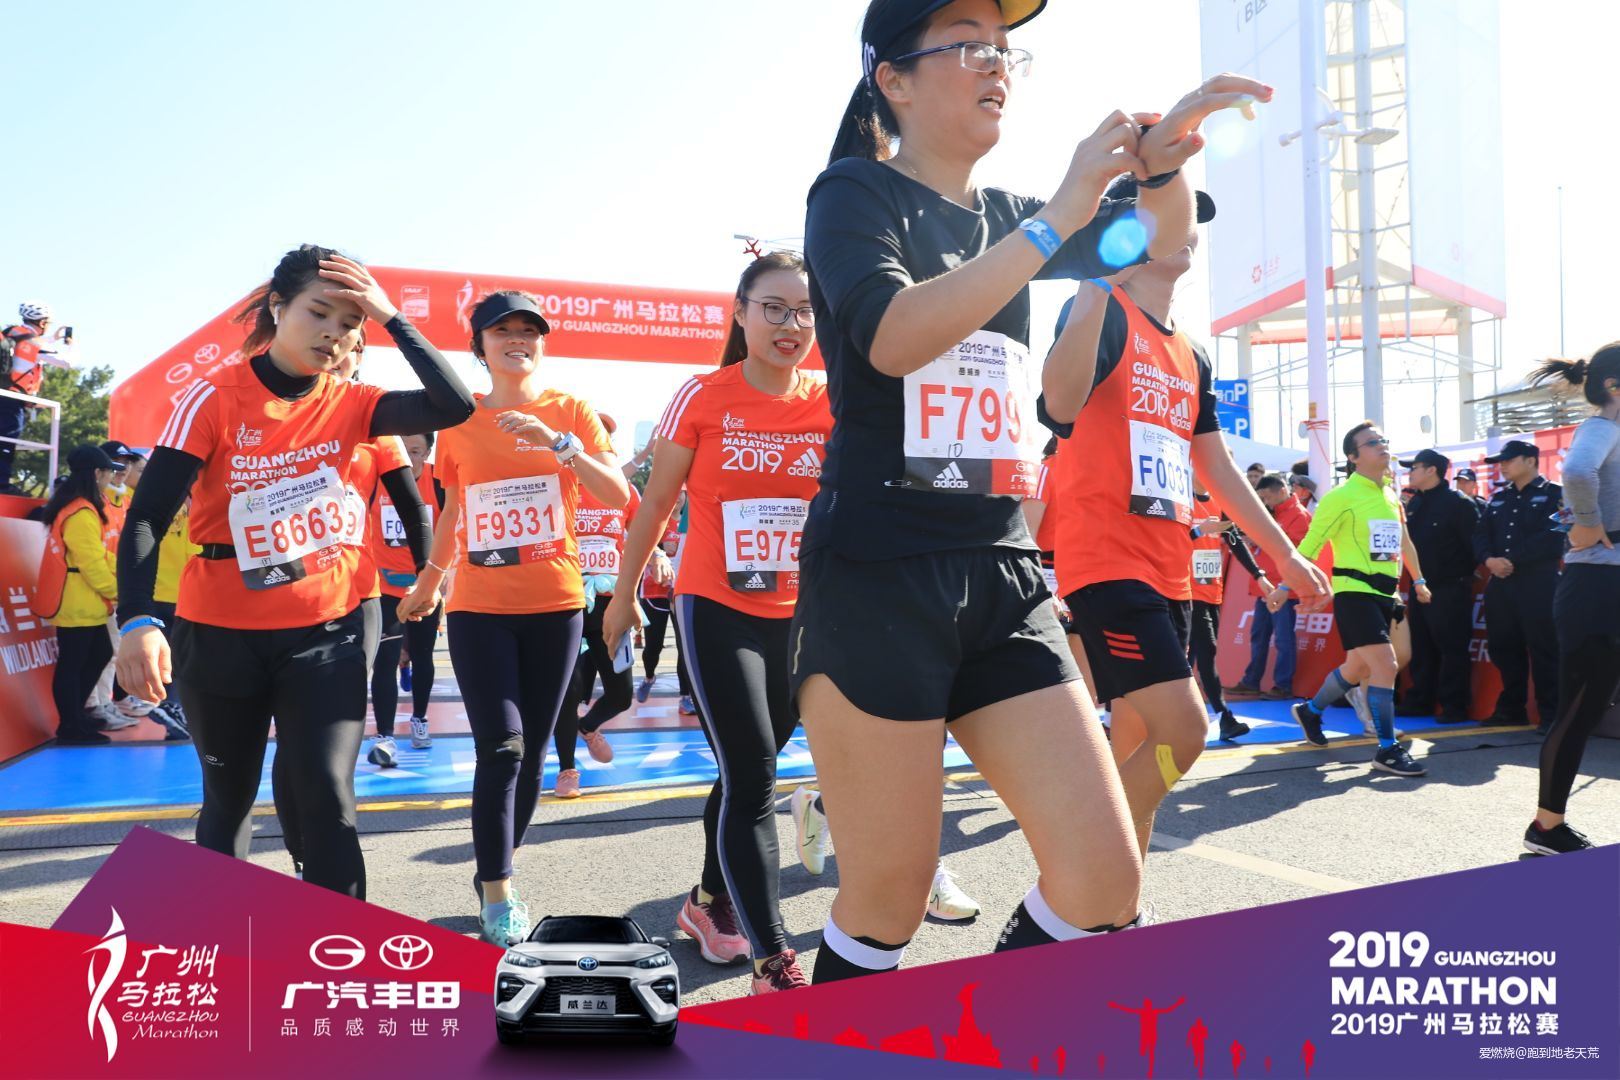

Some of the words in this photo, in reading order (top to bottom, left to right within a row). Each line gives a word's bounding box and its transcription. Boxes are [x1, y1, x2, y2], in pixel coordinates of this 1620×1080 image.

[563, 320, 649, 336] GUANGZHOU
[650, 326, 725, 340] MARATHON
[1132, 361, 1196, 396] GUANGZHOU
[1132, 376, 1169, 395] MARATHON
[1132, 387, 1170, 417] 2019
[1170, 414, 1192, 431] adidas
[722, 438, 785, 451] MARATHON
[231, 439, 341, 470] GUANGZHOU
[722, 446, 783, 474] 2019
[231, 465, 298, 480] MARATHON
[787, 465, 822, 478] adida
[933, 480, 969, 489] adidas
[576, 508, 624, 516] UANGZHOU
[244, 502, 343, 558] E8663
[475, 504, 555, 542] F9331
[264, 576, 291, 585] adidas
